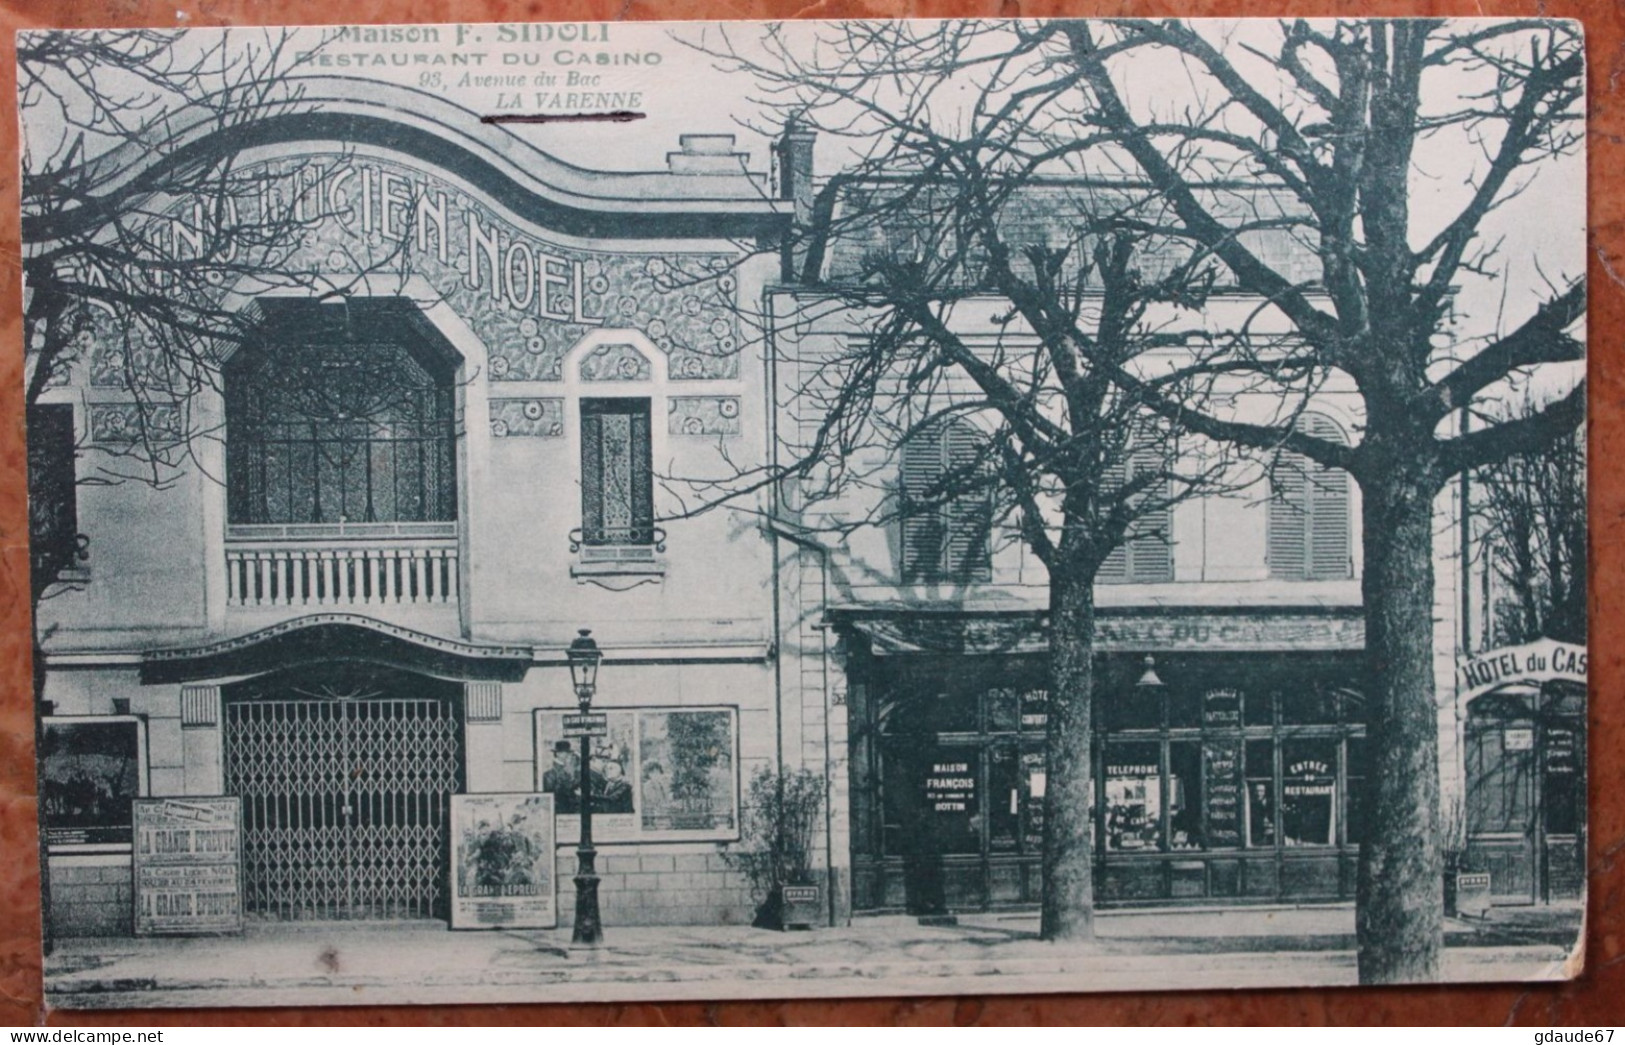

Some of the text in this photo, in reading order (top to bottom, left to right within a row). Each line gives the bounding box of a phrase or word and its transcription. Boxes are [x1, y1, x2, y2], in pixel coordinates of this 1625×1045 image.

[339, 25, 439, 43] Maison
[497, 24, 610, 42] SIDOLI
[295, 51, 662, 66] RESTAURANT DU CASINO
[419, 71, 600, 90] 93, Avenue du Bac
[495, 92, 643, 109] LA VARENNE
[260, 163, 448, 266] LUCIEN
[467, 207, 604, 326] NOEL
[1462, 653, 1522, 690] HÔTEL
[1526, 653, 1546, 672] du
[934, 763, 968, 773] MAISON
[1107, 765, 1158, 775] TELEPHONE
[1290, 760, 1328, 774] ENTREE
[927, 779, 974, 789] FRANÇOIS
[1285, 786, 1334, 795] RESTAURANT
